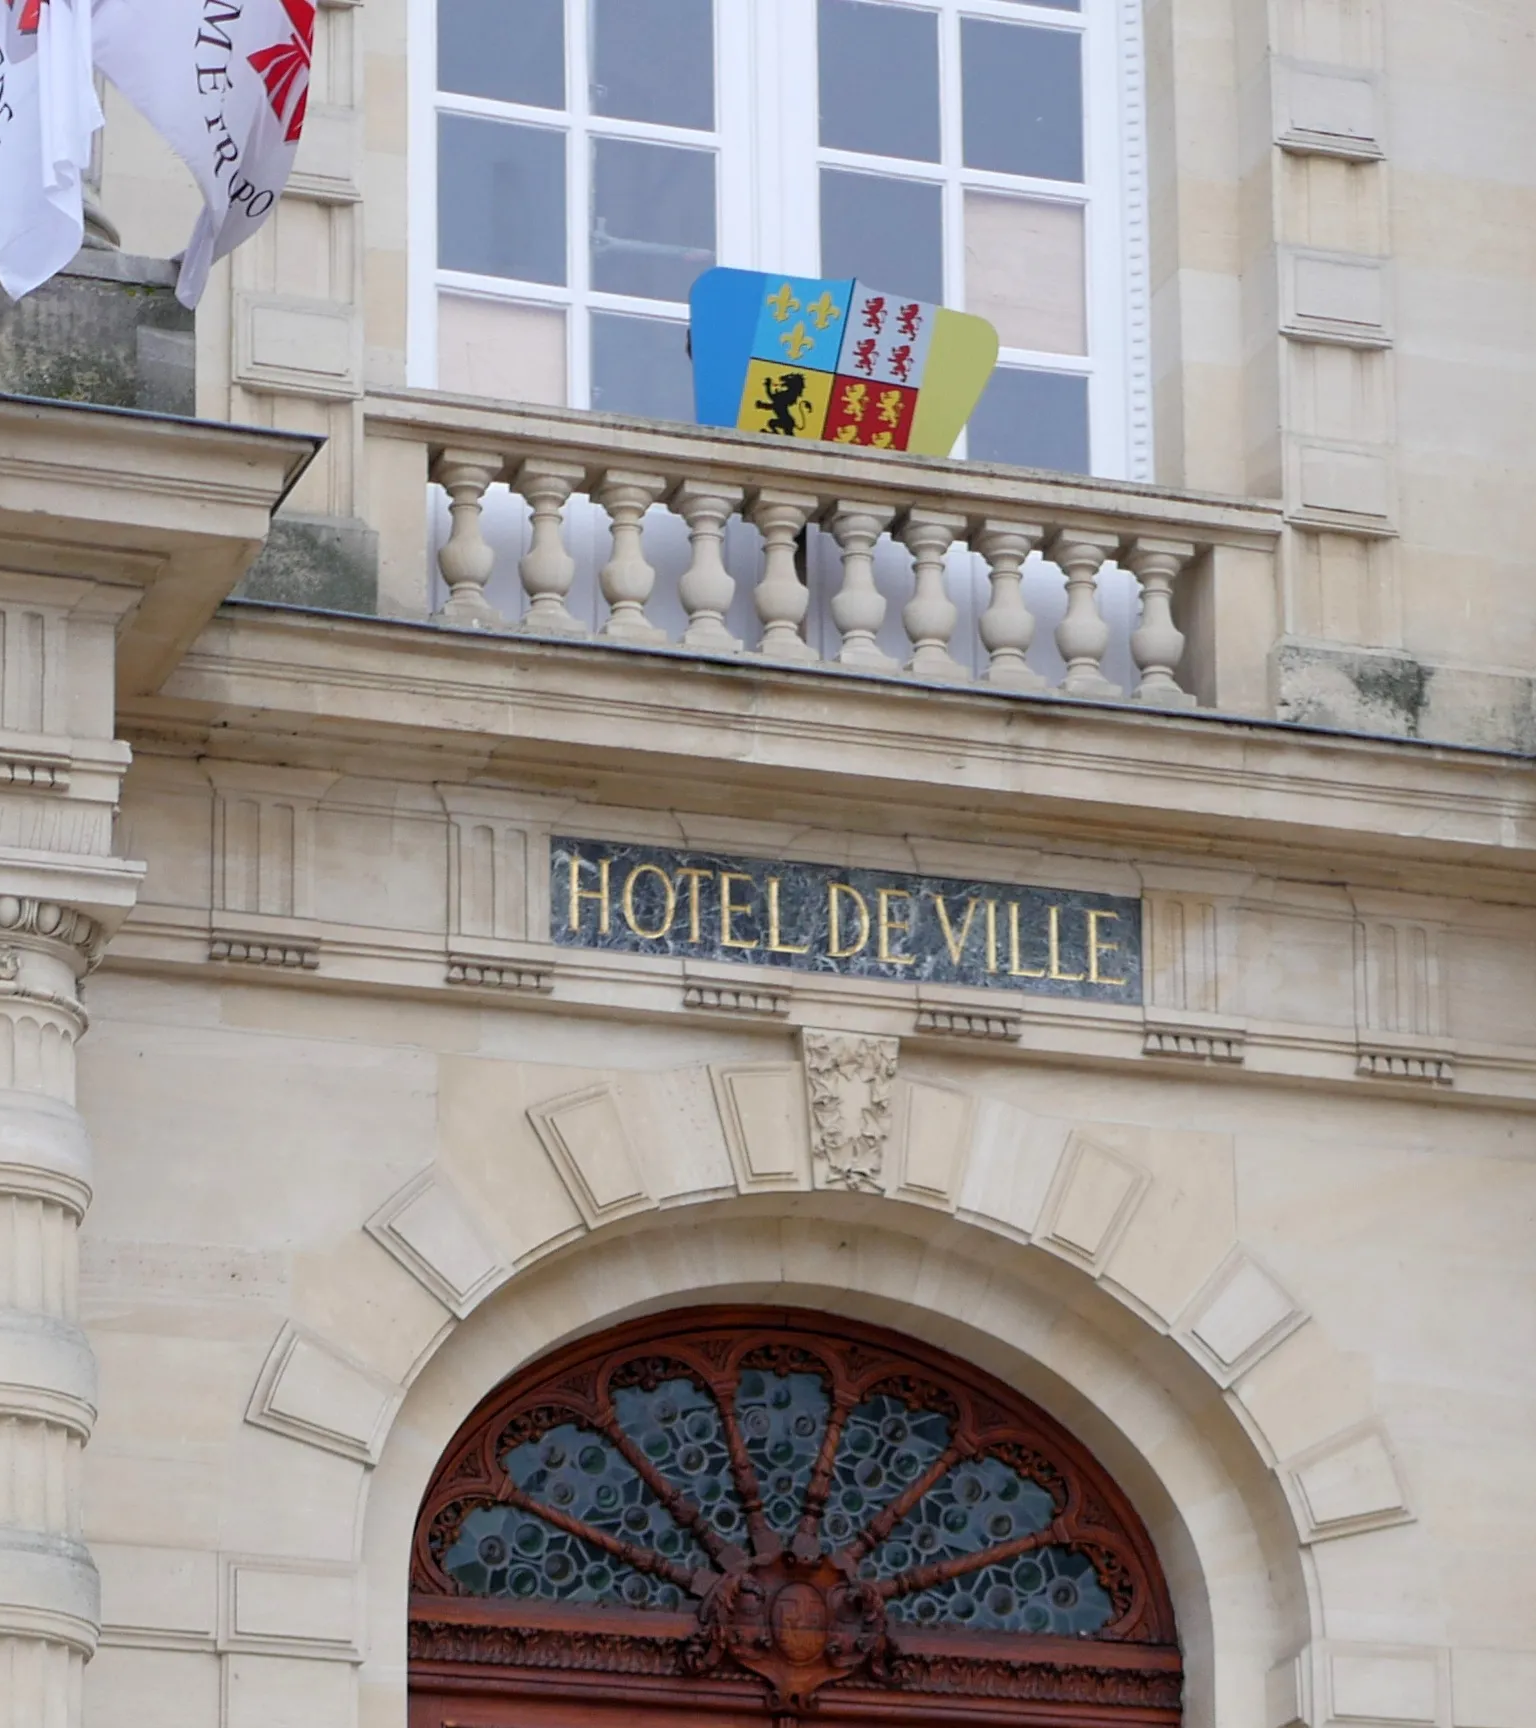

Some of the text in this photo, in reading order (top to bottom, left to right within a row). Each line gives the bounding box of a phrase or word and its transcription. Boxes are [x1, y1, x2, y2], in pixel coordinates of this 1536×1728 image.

[568, 856, 1126, 985] HOTEL DE VILLE
